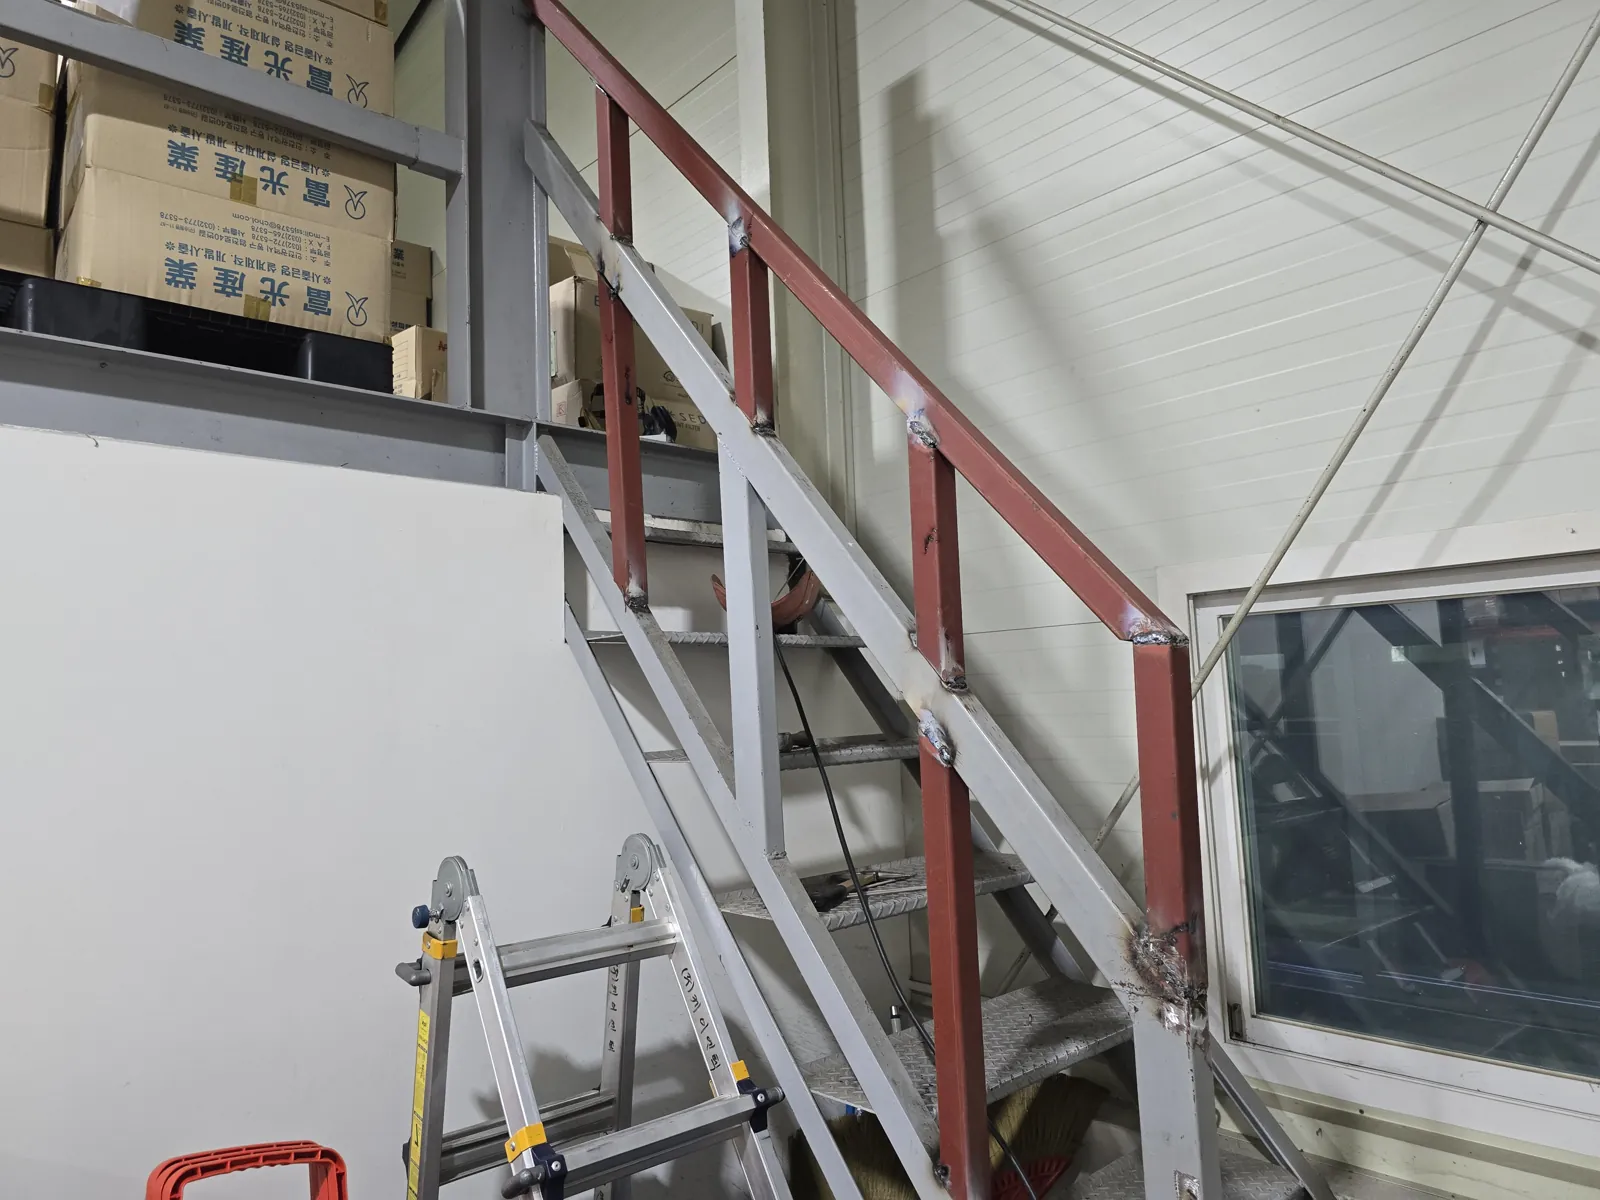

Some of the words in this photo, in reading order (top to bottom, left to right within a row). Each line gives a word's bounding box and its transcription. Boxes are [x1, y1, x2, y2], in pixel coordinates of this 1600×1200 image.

[285, 41, 322, 63] 사출금형
[280, 155, 320, 176] 사출금형
[160, 212, 215, 230] (032)773-5378
[252, 234, 301, 250] (032)772-5378
[267, 245, 302, 260] 인천광역시
[281, 266, 320, 283] 사출금형
